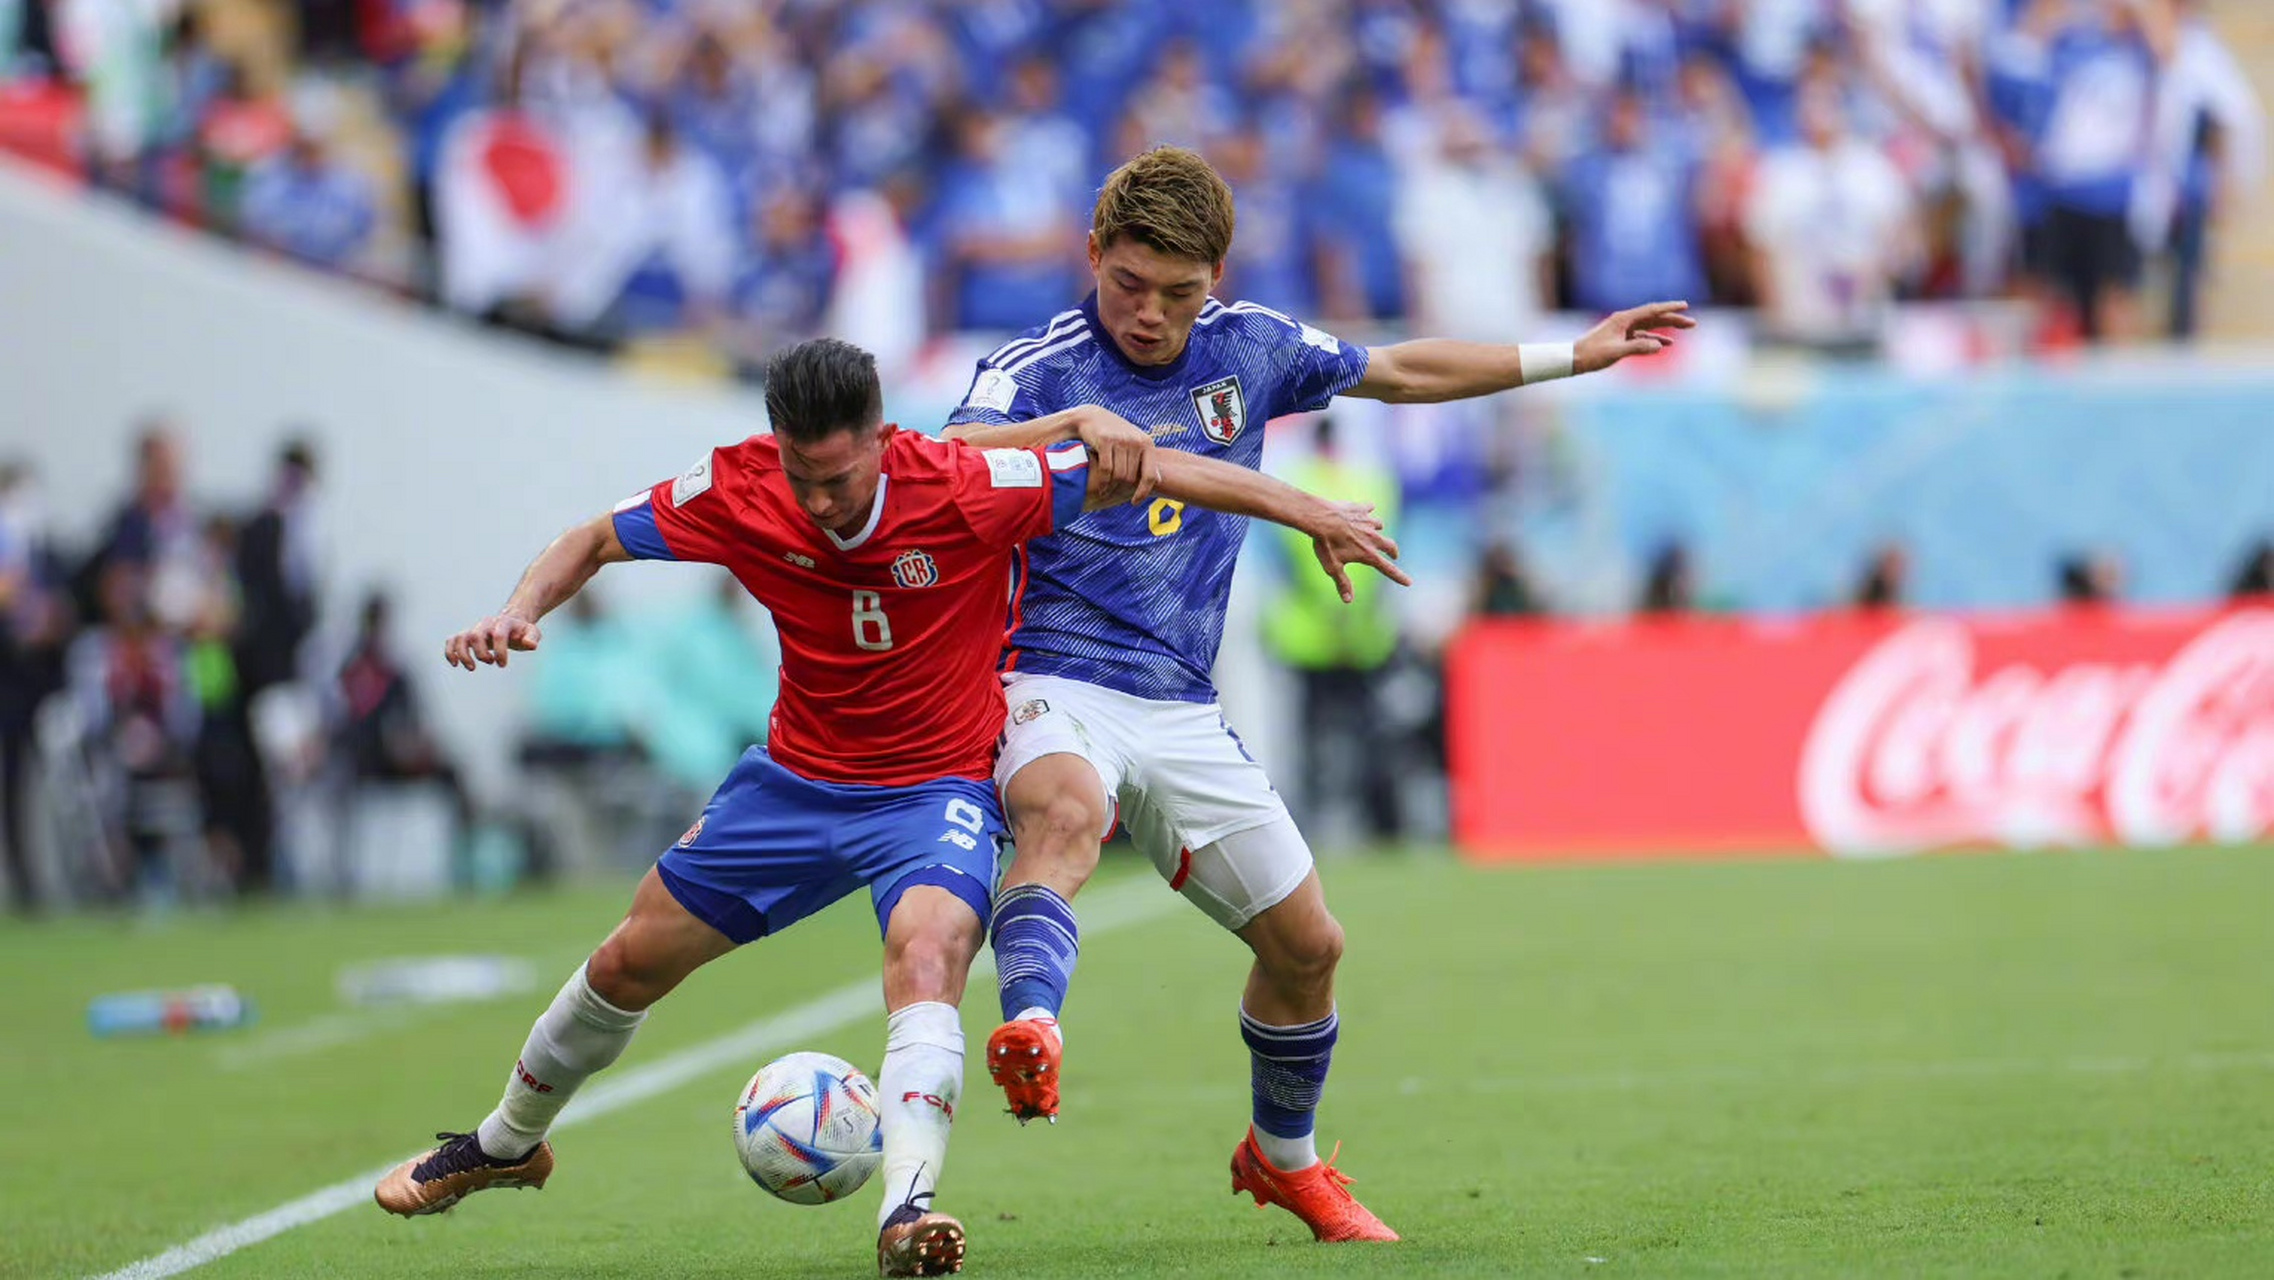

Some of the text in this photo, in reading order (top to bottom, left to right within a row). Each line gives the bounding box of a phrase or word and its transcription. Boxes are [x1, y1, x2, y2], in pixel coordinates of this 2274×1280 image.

[1202, 381, 1227, 394] JAPAN
[901, 557, 929, 585] CR
[852, 589, 893, 651] 8
